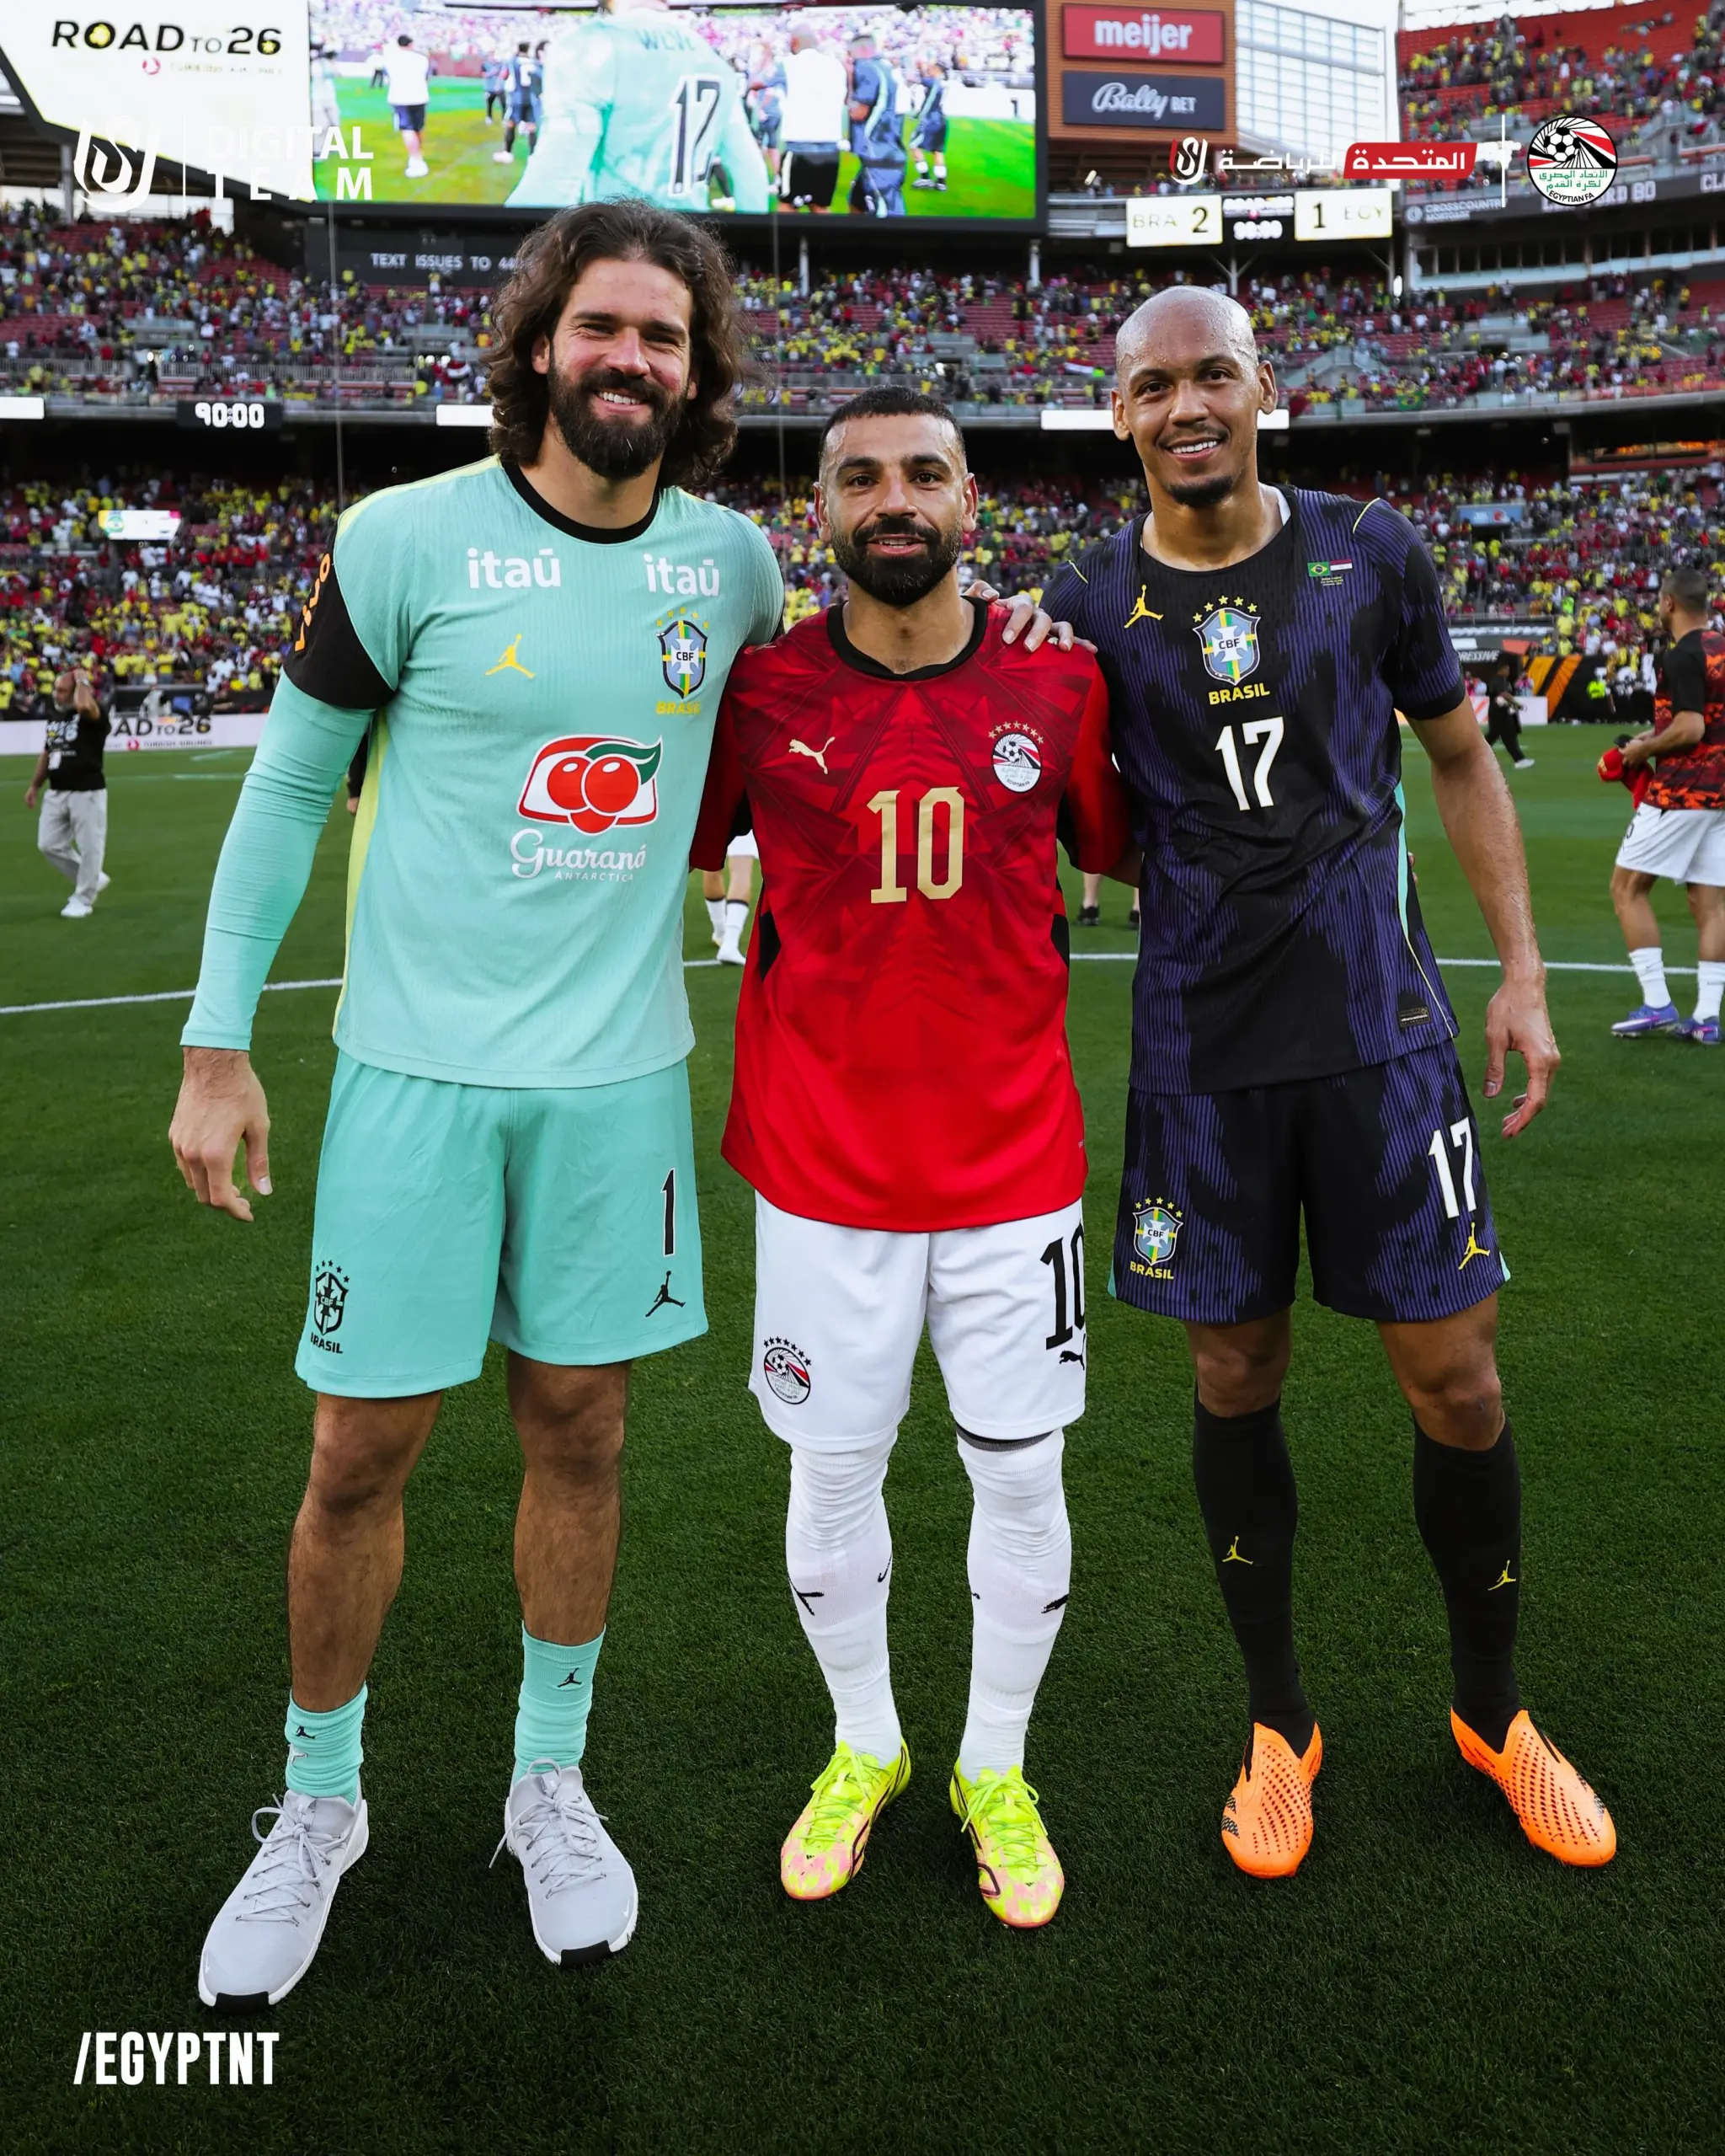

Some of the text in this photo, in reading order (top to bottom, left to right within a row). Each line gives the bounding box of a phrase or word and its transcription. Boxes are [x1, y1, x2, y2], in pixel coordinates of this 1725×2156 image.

[51, 20, 282, 56] ROAD TO 26
[1094, 14, 1192, 56] meijer
[1092, 82, 1197, 120] Bally BET
[1133, 214, 1178, 227] BRA
[1192, 206, 1209, 233] 2
[1313, 202, 1326, 229] 1
[1343, 205, 1385, 220] EGY
[371, 253, 407, 269] TEXT
[415, 254, 463, 270] ISSUES
[470, 256, 492, 271] TO
[195, 402, 264, 428] 90:00
[676, 651, 694, 661] CBF
[1219, 638, 1241, 650] CBF
[1458, 650, 1499, 662] RESSIVE
[1208, 683, 1270, 706] BRASIL
[179, 716, 211, 735] 26
[1215, 716, 1284, 811] 17
[510, 828, 647, 879] Guaraná
[867, 786, 964, 904] 10
[555, 870, 633, 882] ANTARCTICA
[1428, 1116, 1477, 1219] 17
[661, 1168, 676, 1257] 1
[1147, 1229, 1164, 1238] CBF
[1130, 1260, 1174, 1280] BRASIL
[320, 1296, 334, 1307] CBF
